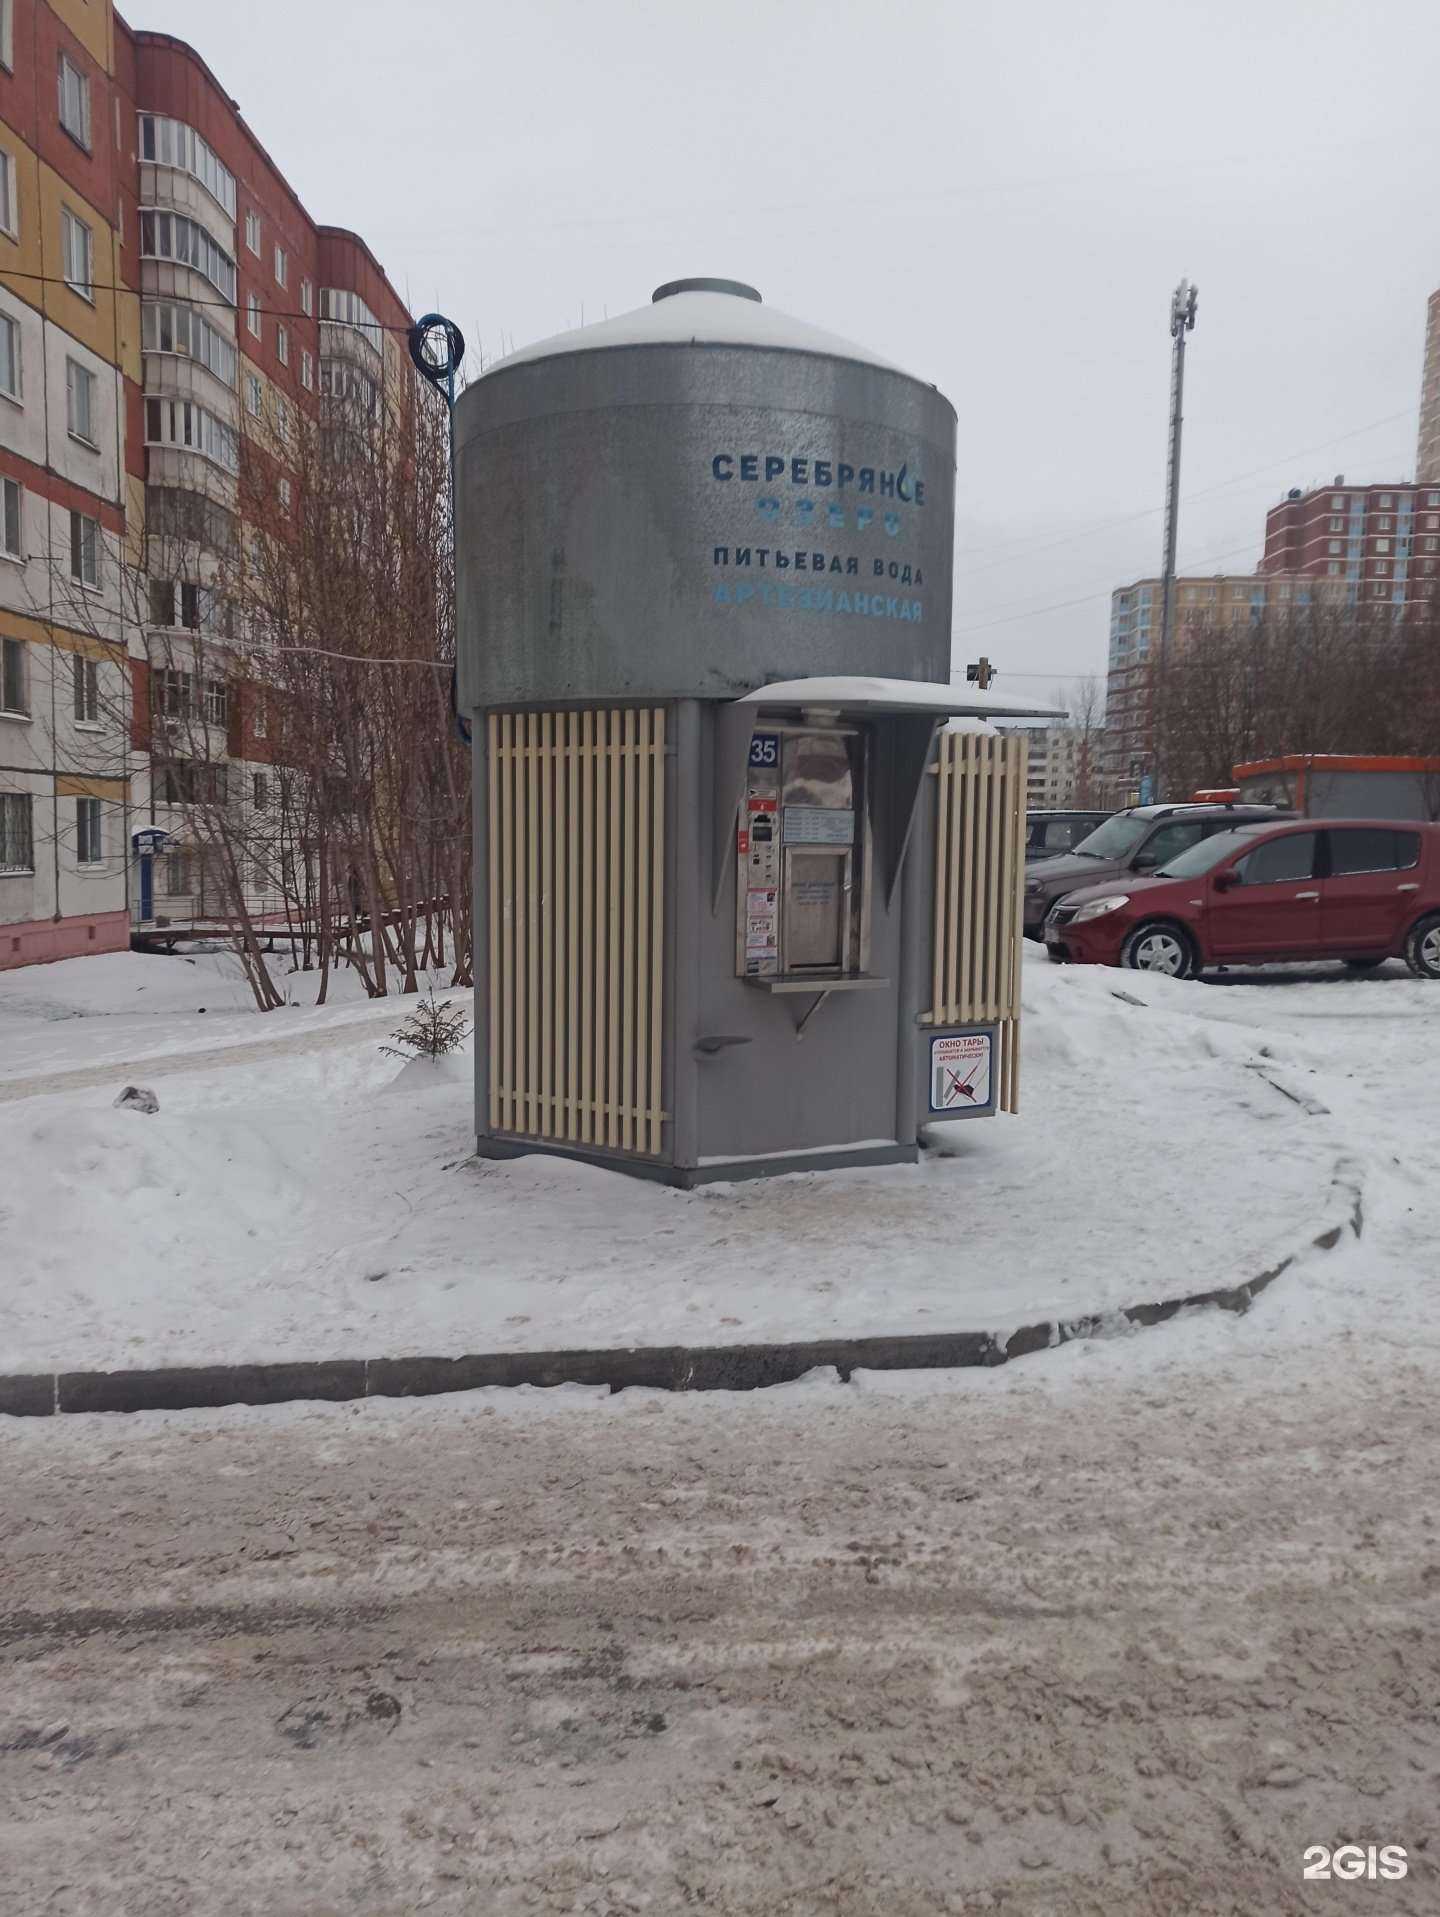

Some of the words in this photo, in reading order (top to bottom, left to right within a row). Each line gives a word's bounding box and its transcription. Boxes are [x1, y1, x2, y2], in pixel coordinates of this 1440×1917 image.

[713, 547, 858, 576] ПИТЬЕВАЯ
[873, 558, 923, 586] ВОДА
[713, 583, 923, 622] АРТЕЗИАНСКАЯ
[750, 739, 777, 763] 35
[939, 1040, 961, 1049] ОКНО
[963, 1037, 984, 1047] ТАРЫ
